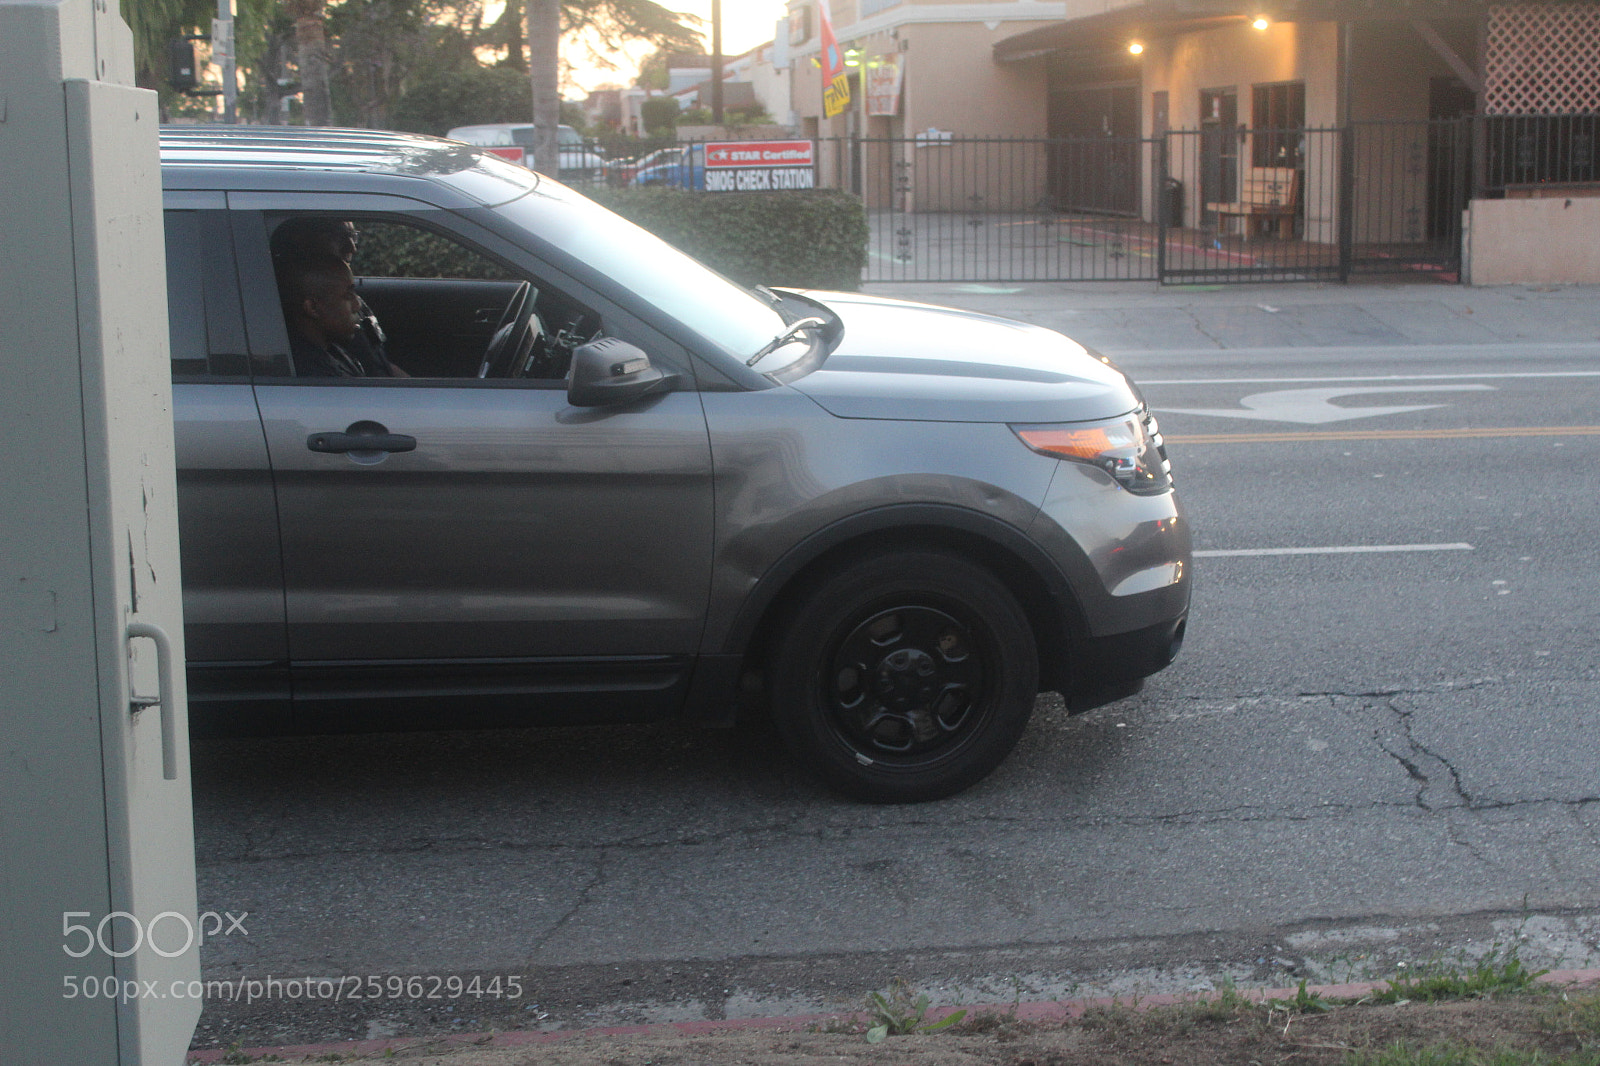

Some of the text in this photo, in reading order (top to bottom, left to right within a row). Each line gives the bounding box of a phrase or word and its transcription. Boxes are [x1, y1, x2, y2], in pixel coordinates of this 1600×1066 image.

[731, 149, 810, 161] STAR Certified
[705, 168, 814, 192] SMOG CHECK STATION
